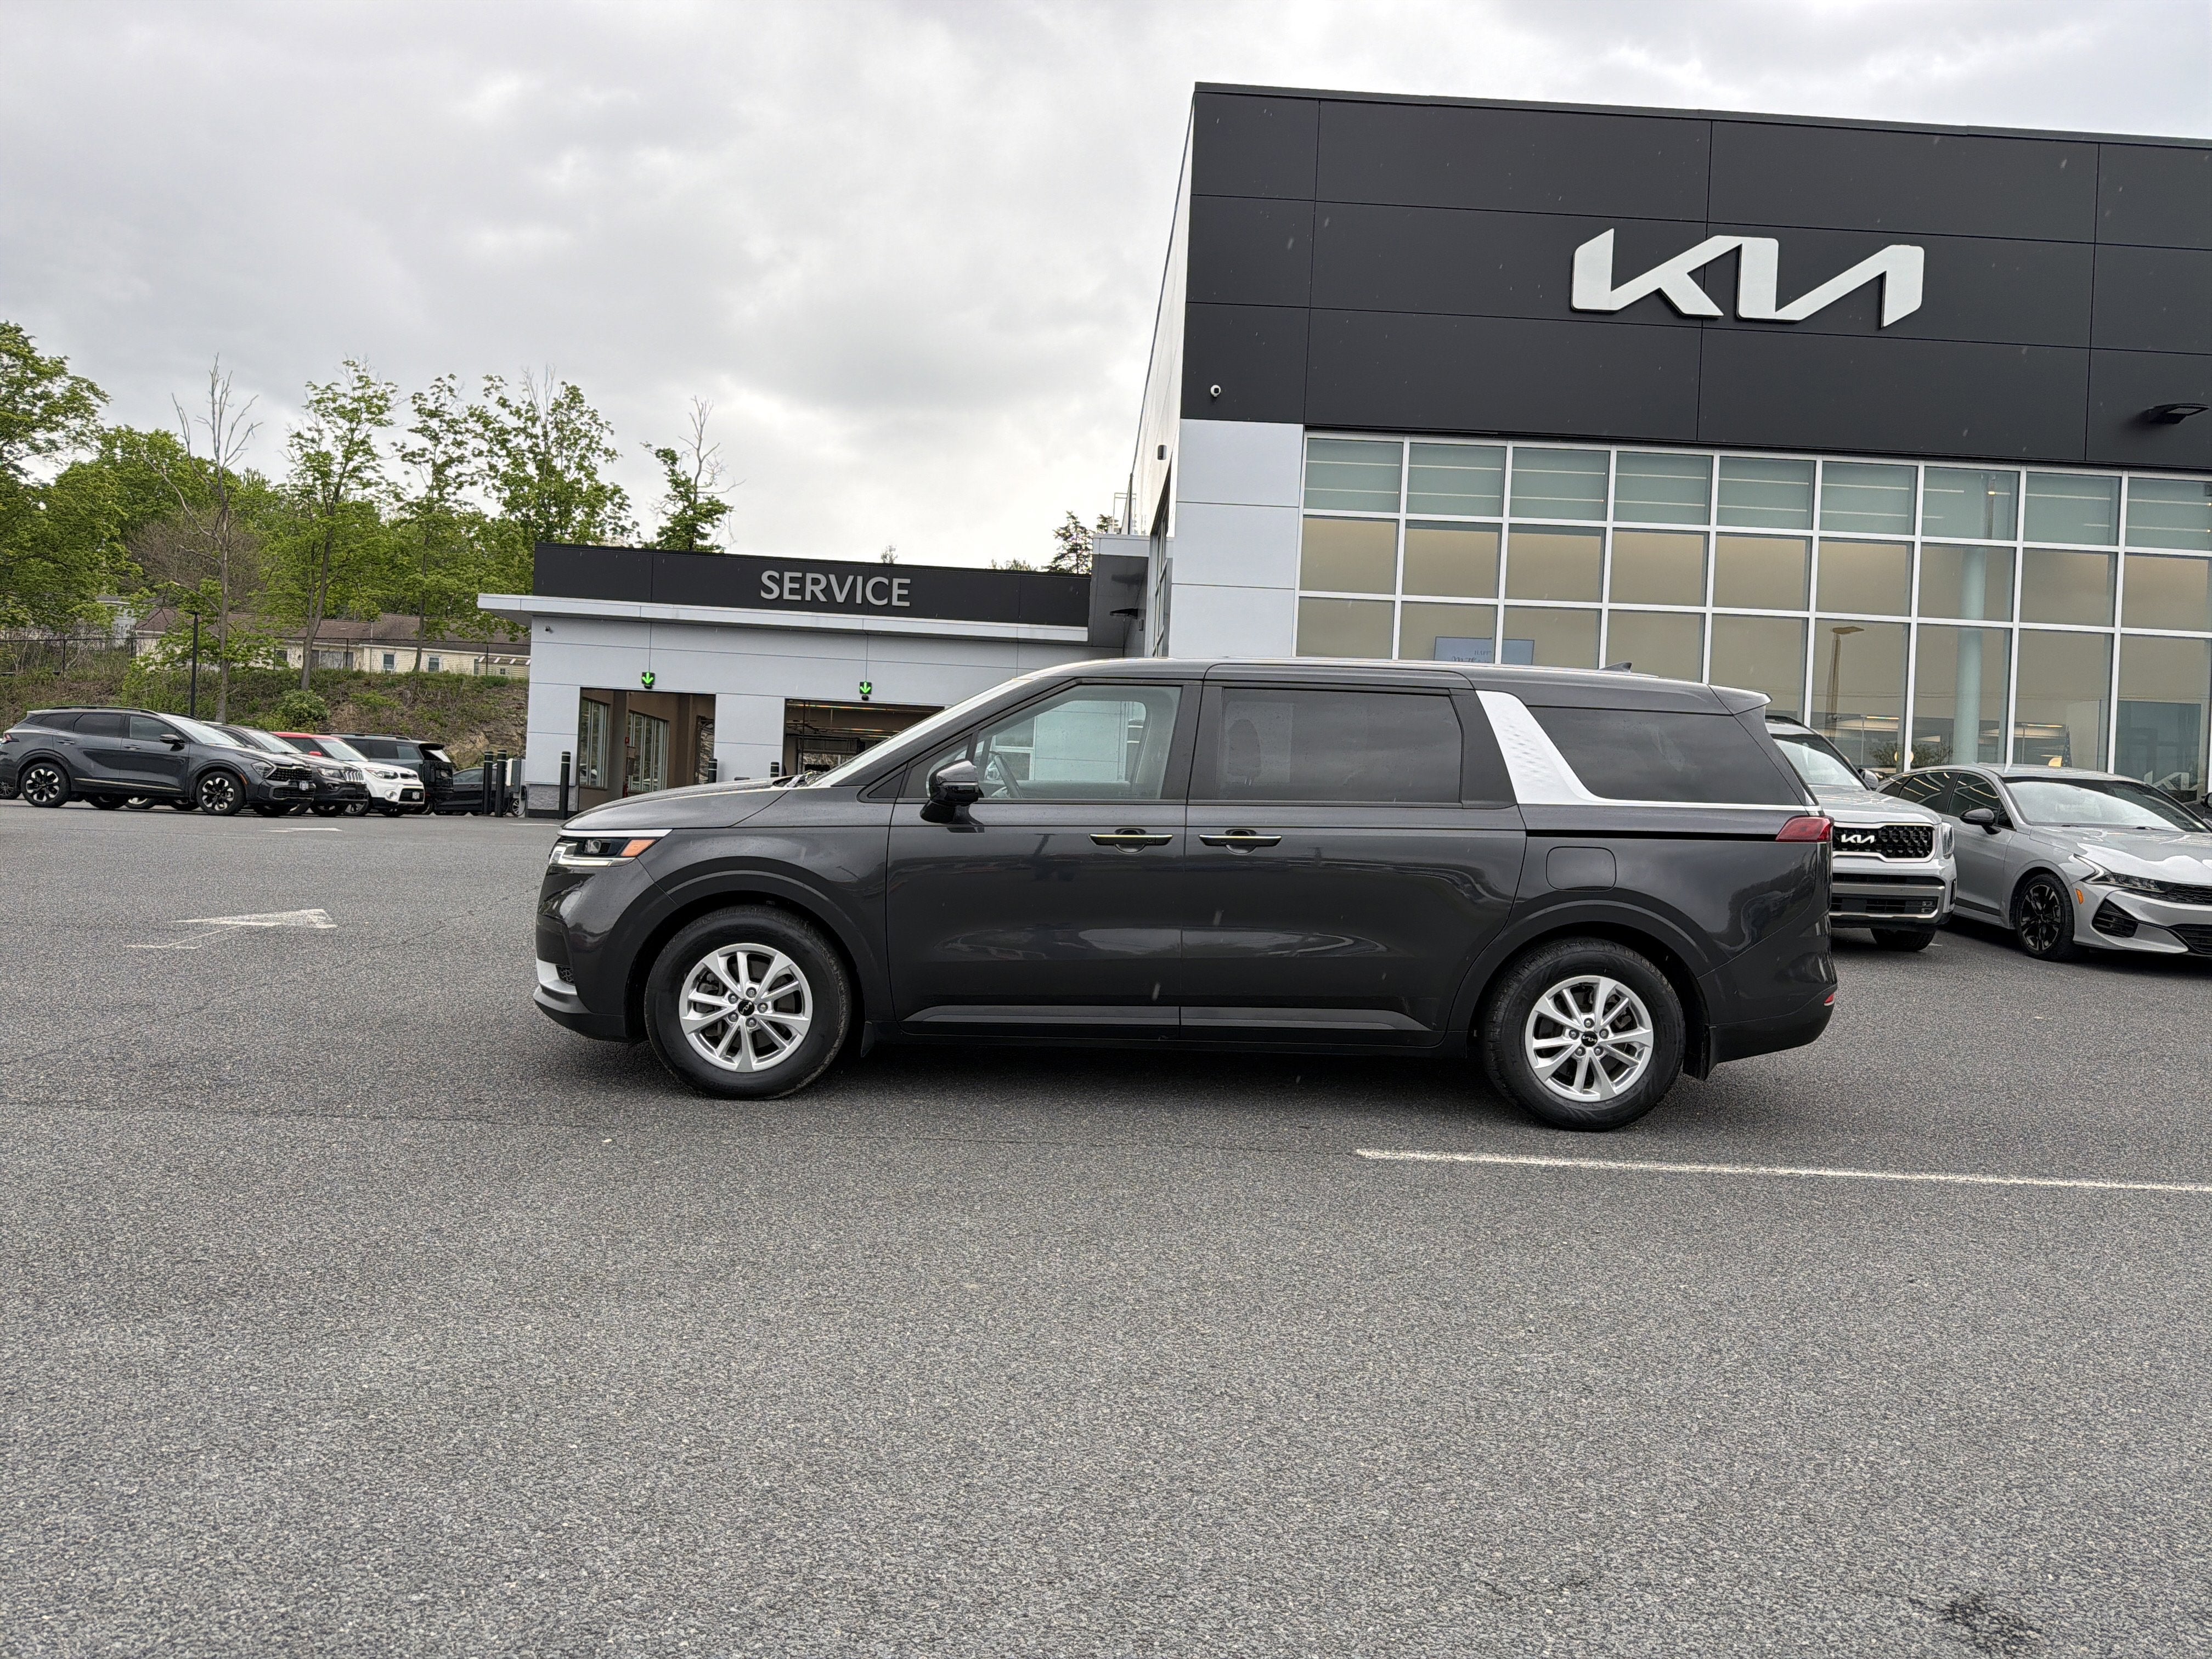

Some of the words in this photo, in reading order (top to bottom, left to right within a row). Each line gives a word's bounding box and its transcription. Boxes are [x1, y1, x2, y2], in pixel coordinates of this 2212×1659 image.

[1571, 228, 1925, 328] KIA
[760, 570, 911, 607] SERVICE
[1841, 833, 1875, 844] KIA
